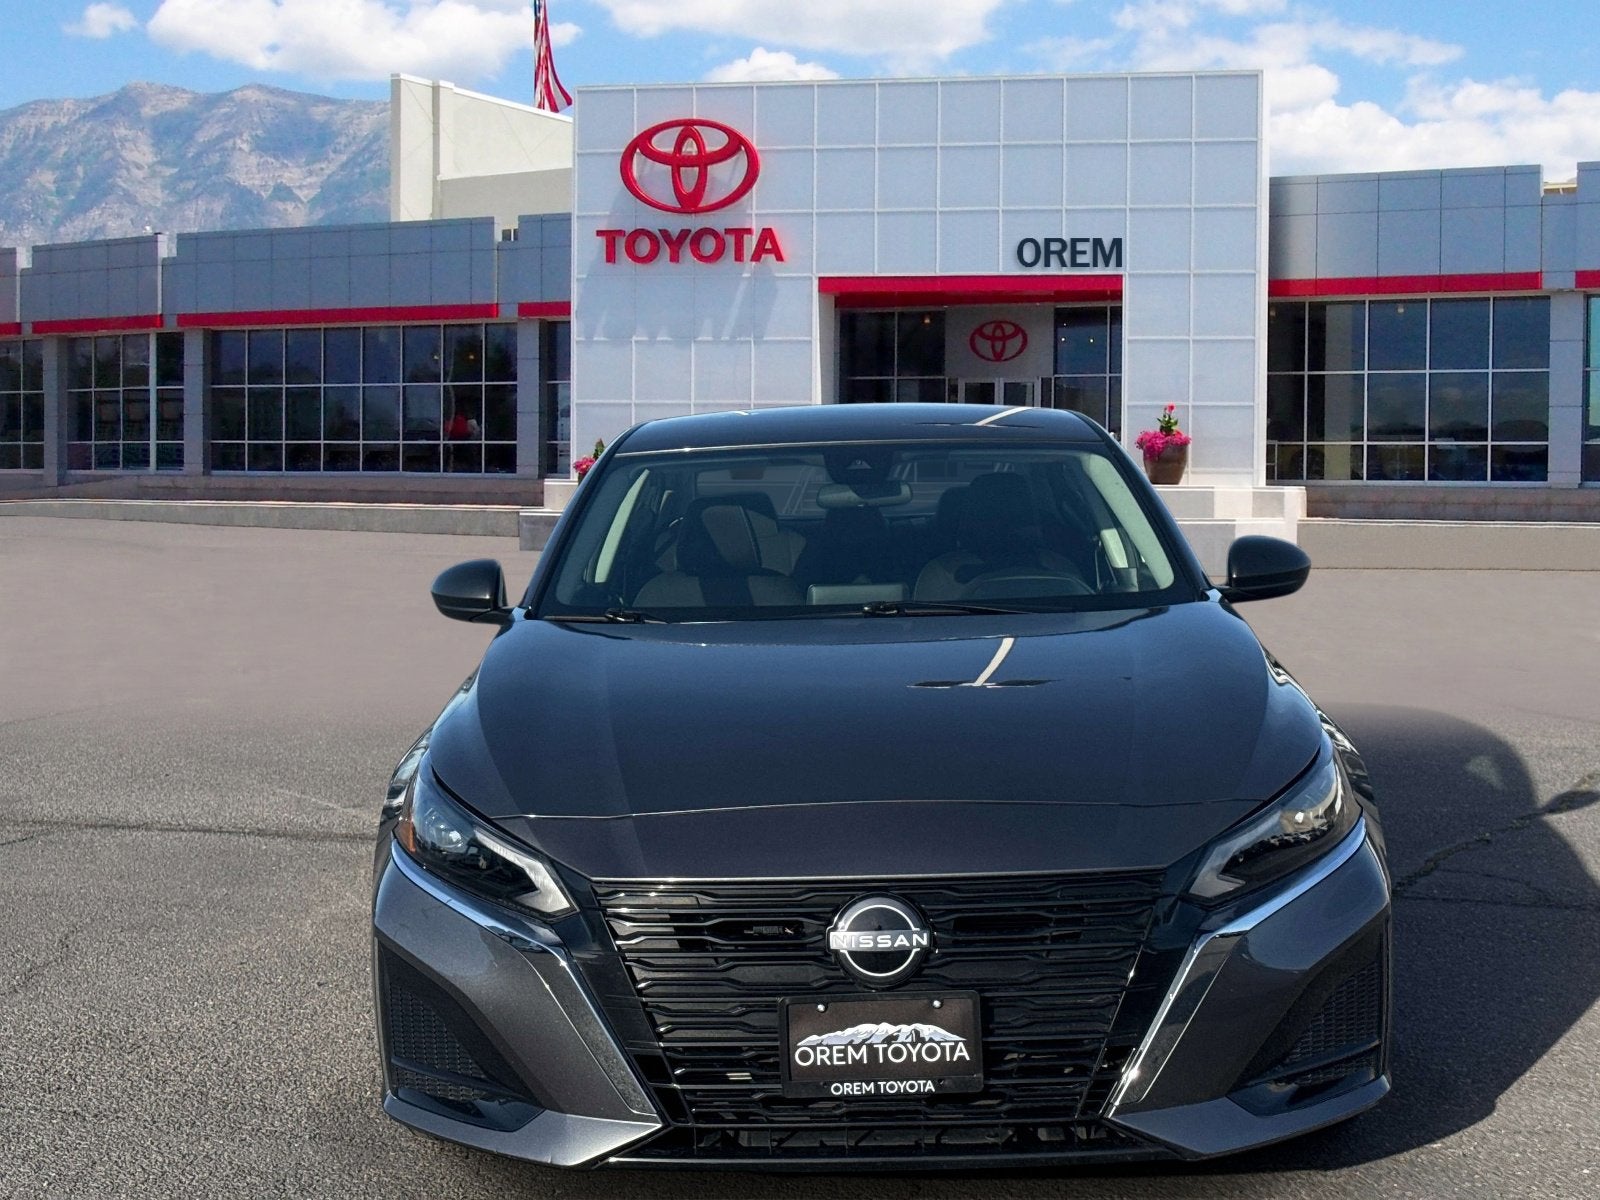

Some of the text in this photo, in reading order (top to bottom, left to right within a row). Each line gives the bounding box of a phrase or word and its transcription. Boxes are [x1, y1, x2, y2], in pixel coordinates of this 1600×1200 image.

[596, 227, 785, 264] TOYOTA
[1016, 237, 1123, 268] OREM
[831, 932, 928, 949] NISSAN
[794, 1041, 970, 1067] OREM TOYOTA
[830, 1079, 935, 1095] OREM TOYOTA
